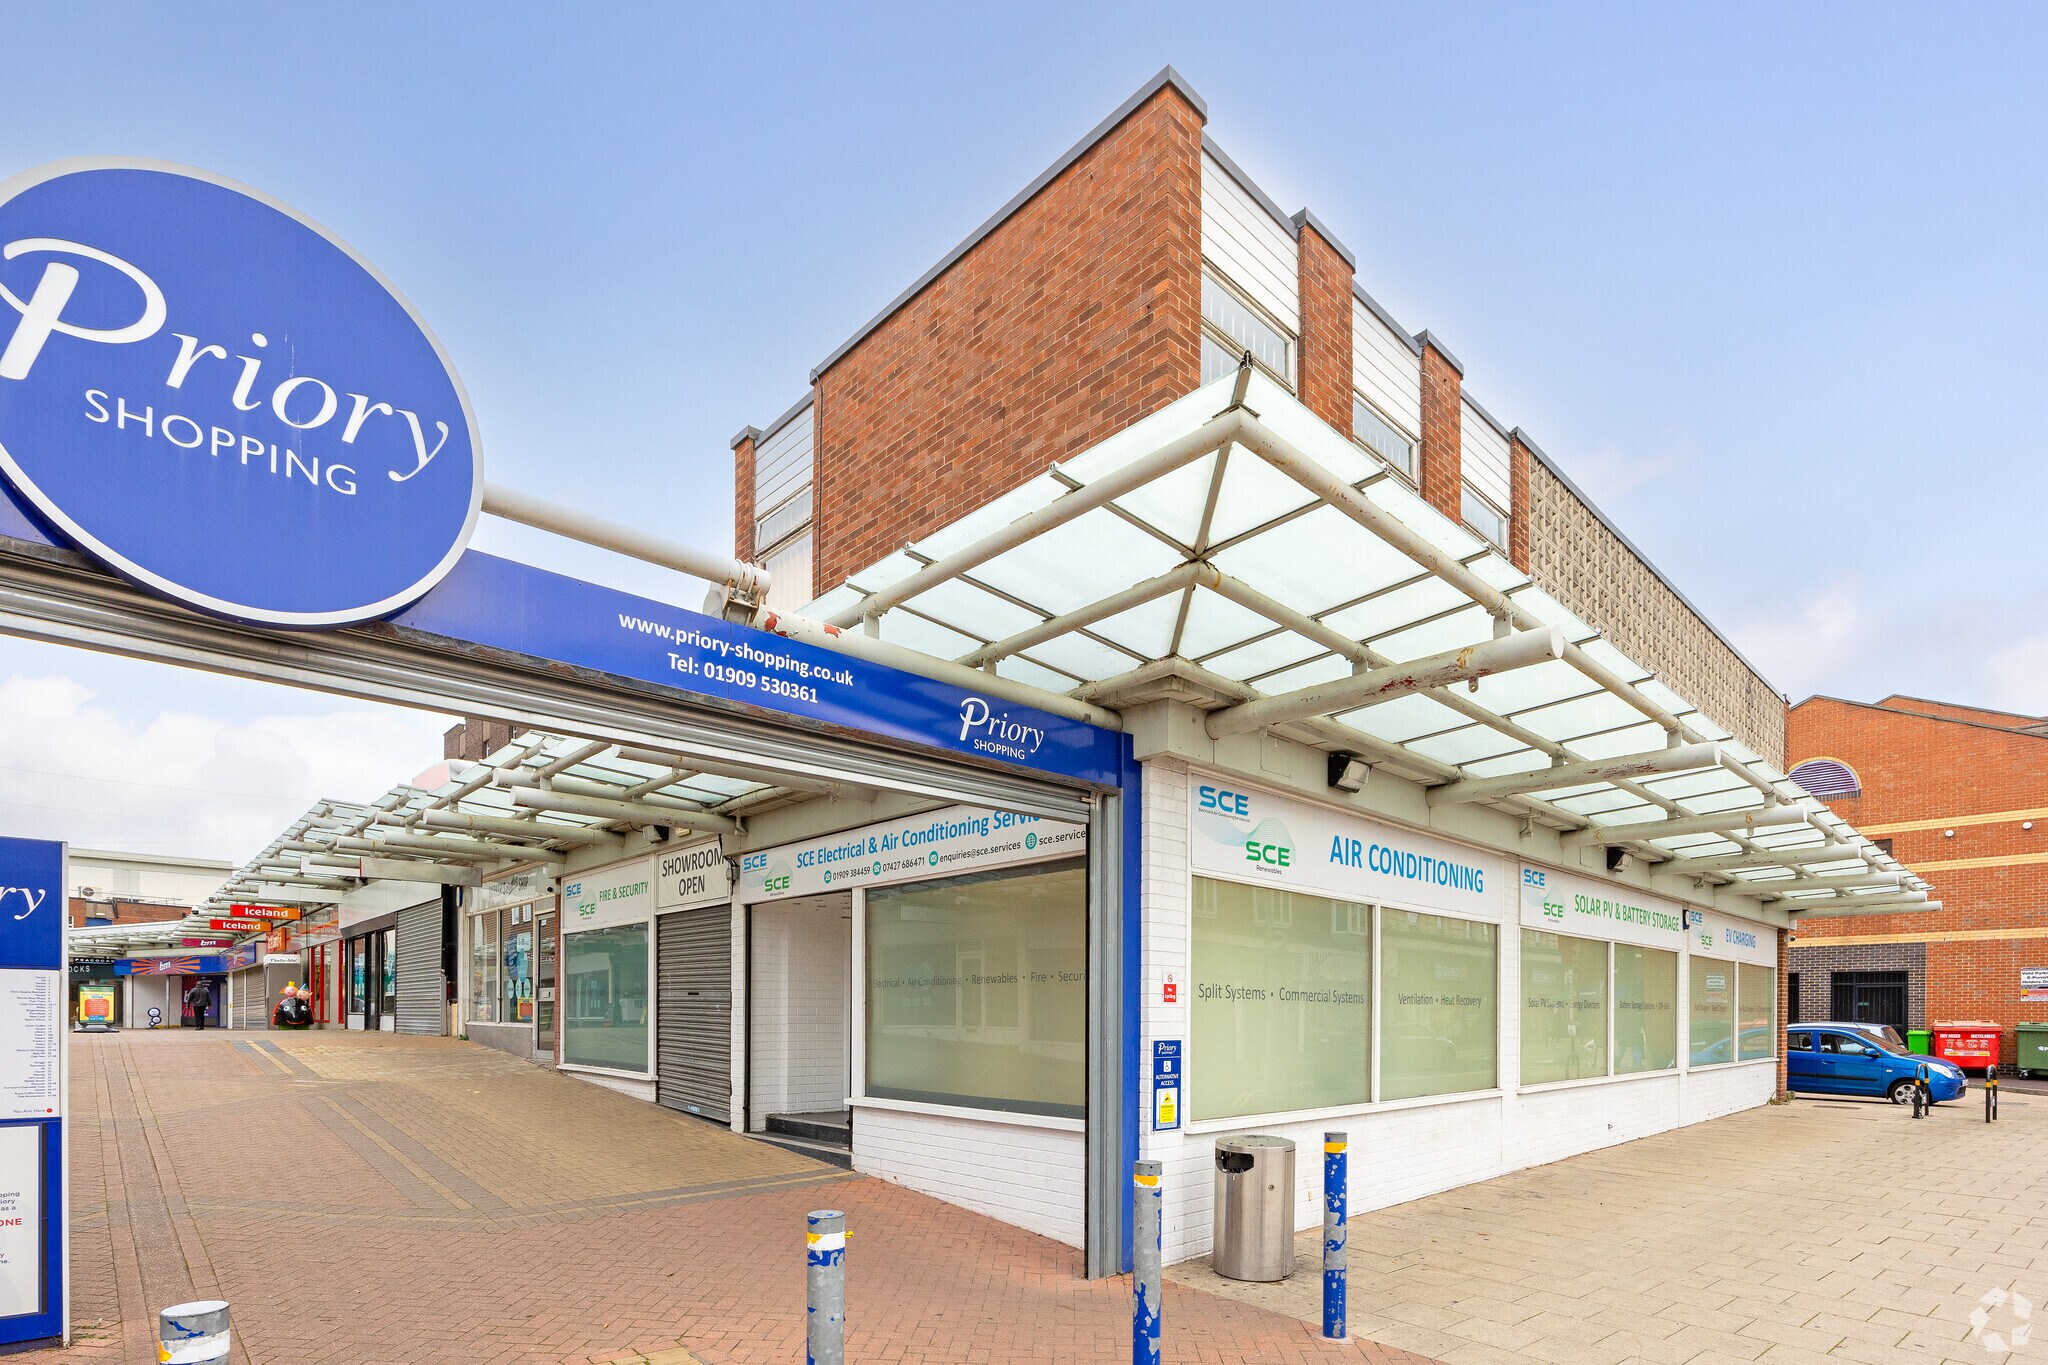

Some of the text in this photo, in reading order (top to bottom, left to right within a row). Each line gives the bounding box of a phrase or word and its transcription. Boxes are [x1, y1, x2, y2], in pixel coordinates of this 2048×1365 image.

[0, 238, 450, 482] Priory
[85, 388, 357, 495] SHOPPING
[618, 613, 854, 687] www.priory-shopping.co.uk
[667, 652, 818, 704] Tel: 01909 530361
[959, 697, 1044, 753] Priory
[973, 738, 1025, 760] SHOPPING
[1199, 785, 1250, 816] SCE
[797, 850, 815, 869] SCE
[817, 838, 866, 865] Electrical
[868, 836, 878, 854] &
[881, 832, 899, 852] Air
[901, 816, 990, 848] Conditioning
[662, 847, 725, 878] SHOWROOM
[743, 853, 768, 871] SCE
[832, 869, 850, 881] 01909
[850, 866, 871, 878] 384459
[882, 861, 901, 872] 07427
[901, 856, 926, 869] 686471
[939, 841, 1022, 864] enquiries@sce.services
[1246, 840, 1291, 867] SCE
[1329, 835, 1484, 893] AIR CONDITIONING
[1255, 864, 1283, 875] Renewables
[1523, 868, 1546, 886] SCE
[565, 883, 582, 897] SCE
[599, 881, 649, 902] FIRE & SECURITY
[678, 874, 705, 897] OPEN
[764, 875, 790, 892] SCE
[244, 907, 289, 918] Iceland
[579, 903, 596, 917] SCE
[1543, 902, 1564, 918] SCE
[1574, 893, 1680, 932] SOLAR PV & BATTERY STORAGE
[1690, 910, 1703, 924] SCE
[222, 921, 261, 931] Iceland
[1700, 934, 1713, 947] SCE
[1726, 928, 1756, 948] EV CHARGING
[872, 977, 900, 988] Electrical
[907, 977, 917, 987] Air
[917, 974, 962, 988] Conditioning
[971, 973, 1018, 985] Renewables
[1030, 971, 1047, 982] Fire
[1198, 983, 1365, 1007] Split Systems Commercial Systems
[1398, 992, 1482, 1008] Ventilation Heat Recovery
[1158, 1042, 1177, 1054] Priory
